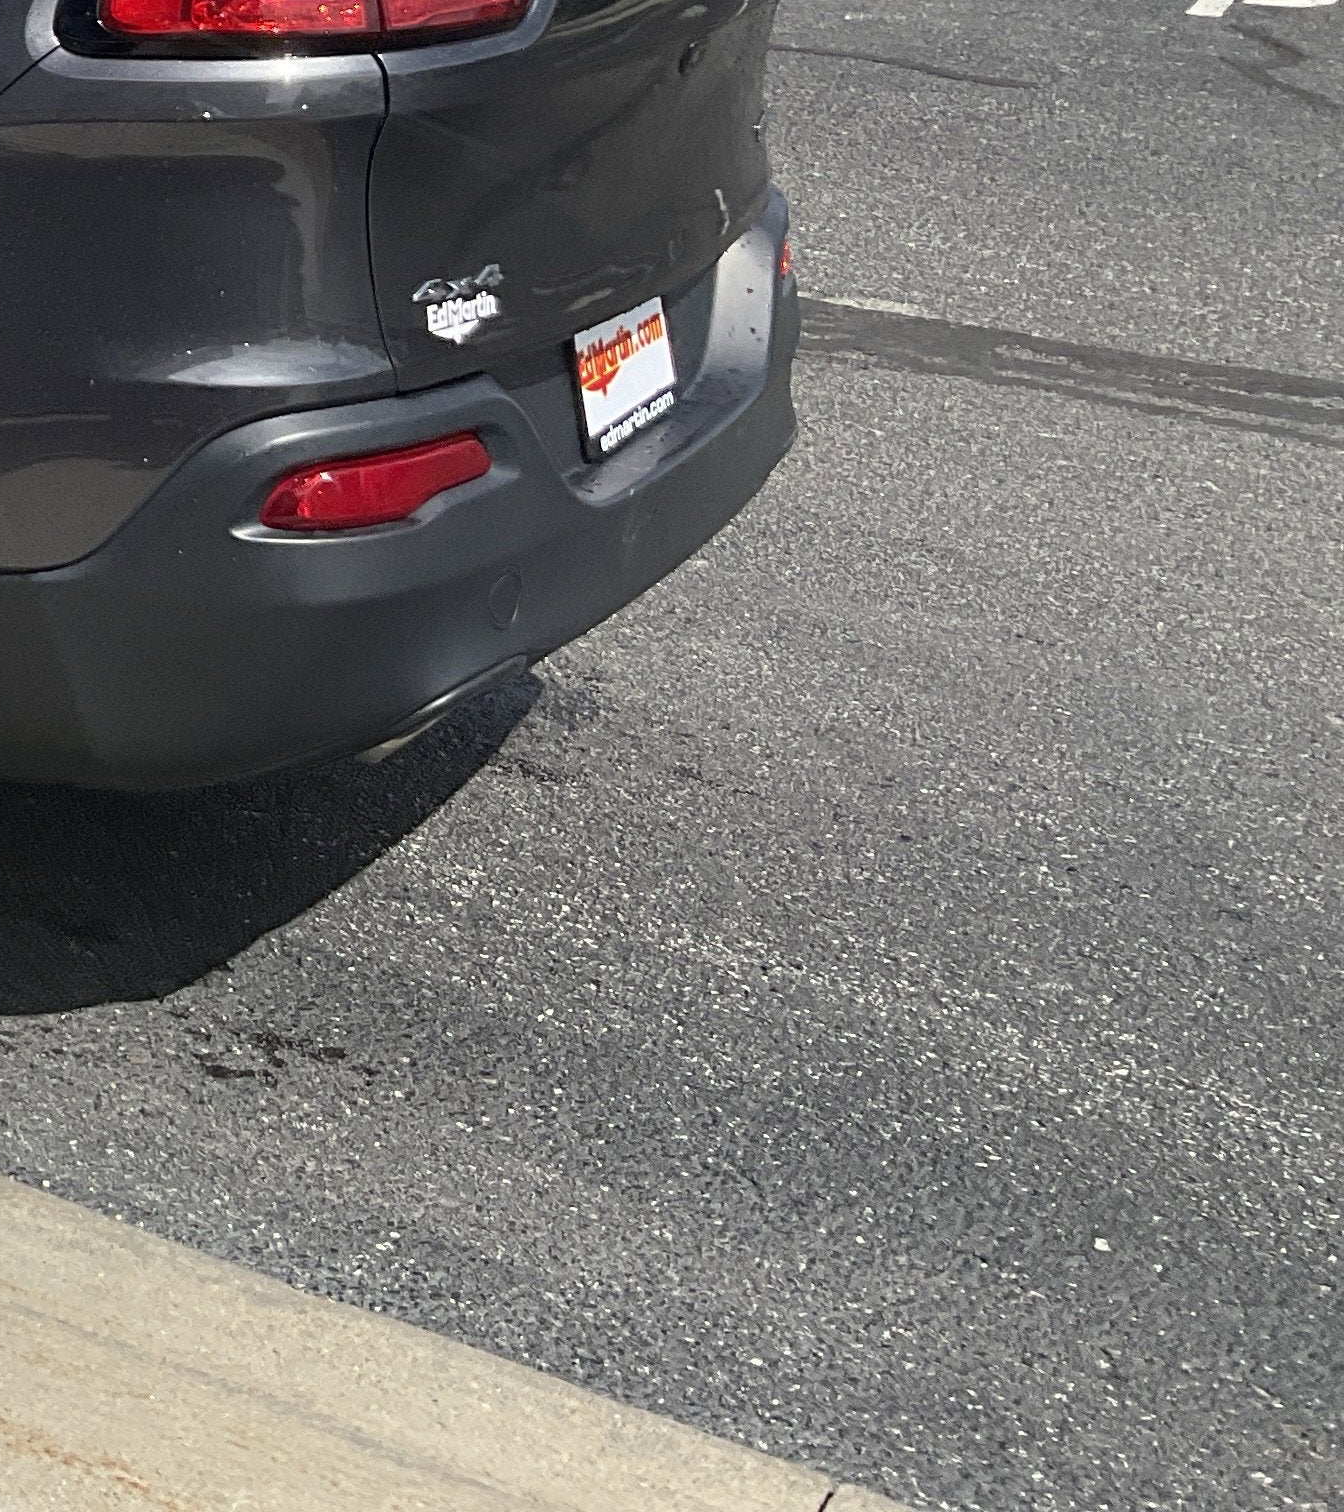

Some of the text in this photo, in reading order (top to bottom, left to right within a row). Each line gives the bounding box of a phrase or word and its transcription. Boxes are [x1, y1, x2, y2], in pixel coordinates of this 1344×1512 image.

[426, 291, 498, 333] EdMartin
[576, 312, 664, 386] EdMartin.com
[600, 390, 675, 452] edmartin.com
